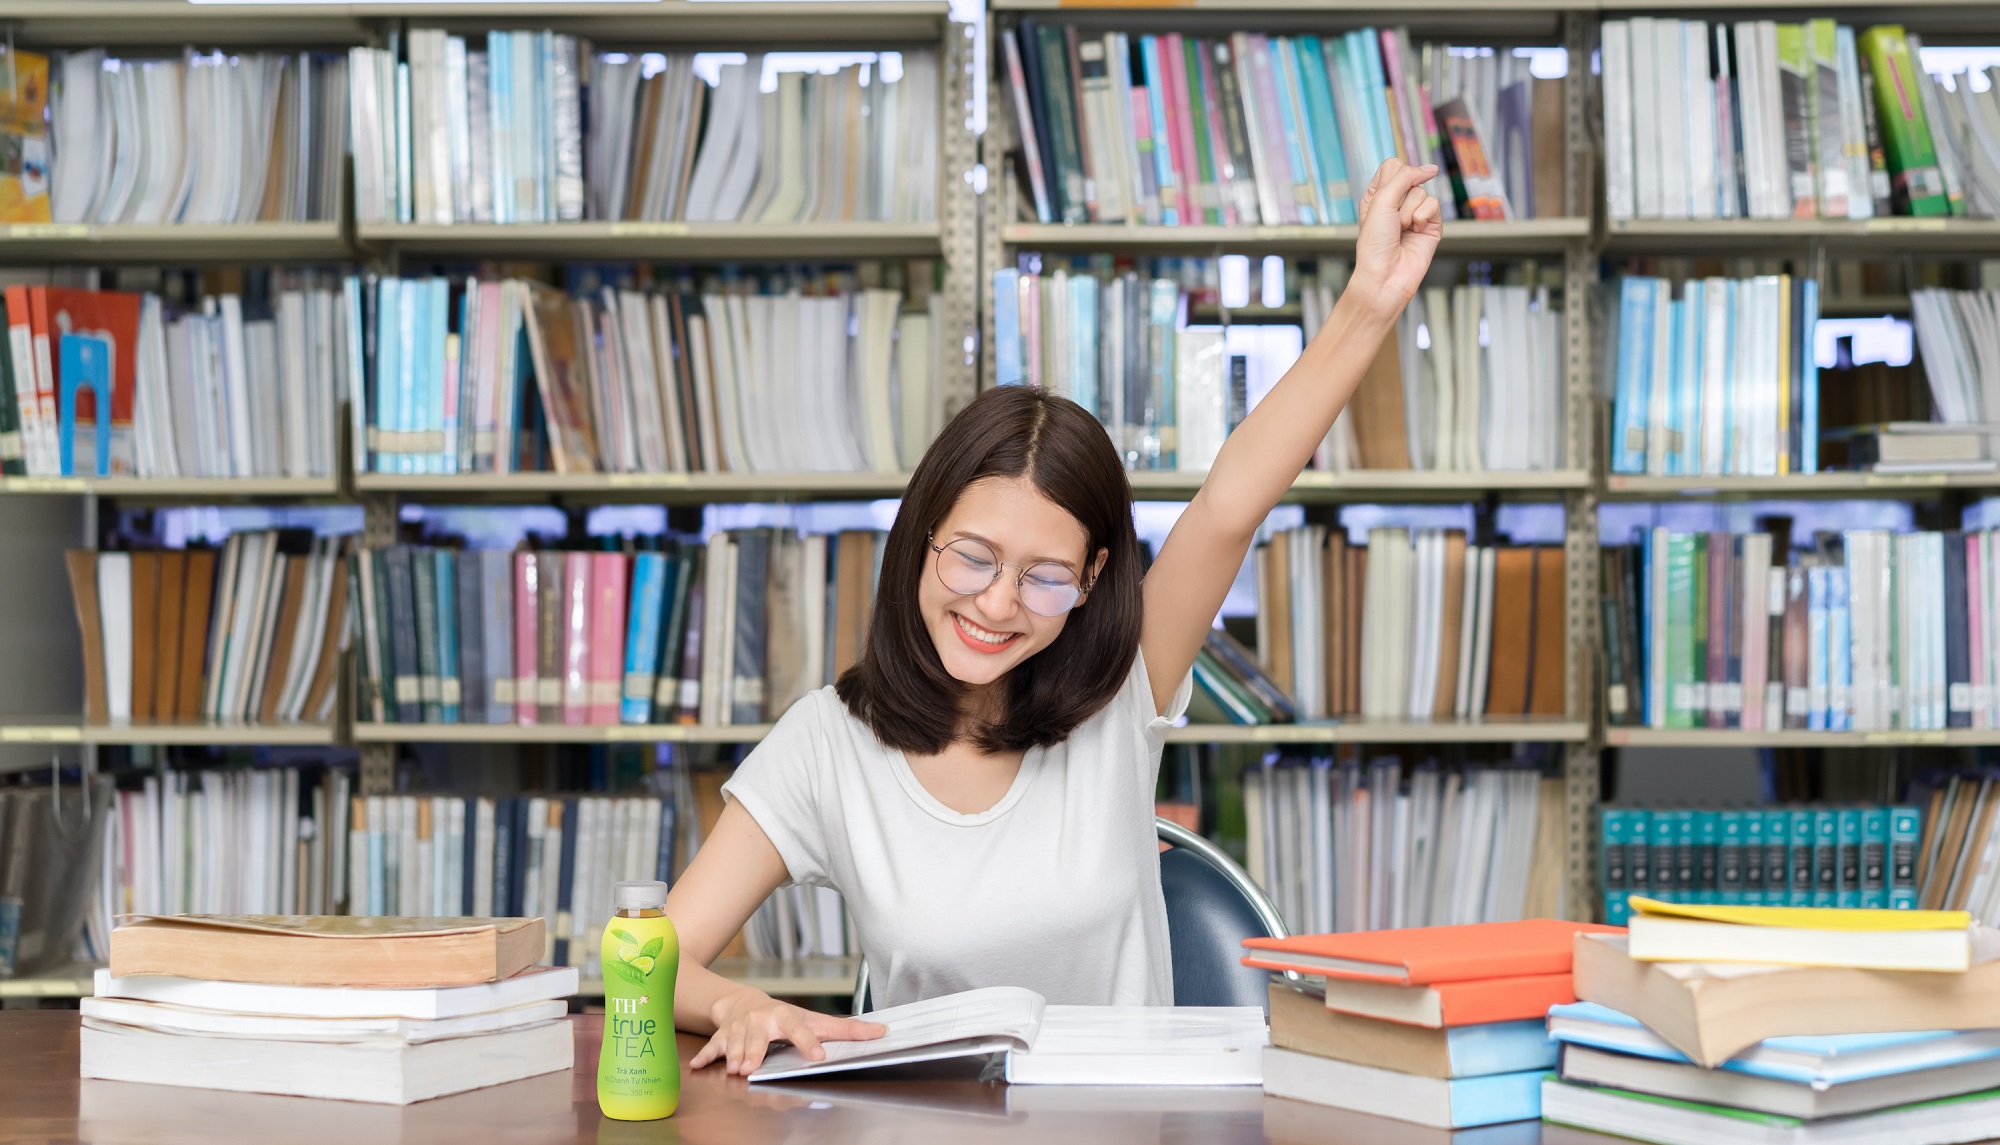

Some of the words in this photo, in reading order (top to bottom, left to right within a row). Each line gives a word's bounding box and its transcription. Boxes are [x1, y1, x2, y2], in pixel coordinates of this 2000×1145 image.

[612, 997, 638, 1014] TH
[612, 1014, 656, 1036] true
[612, 1035, 656, 1058] TEA
[630, 1089, 643, 1097] 350
